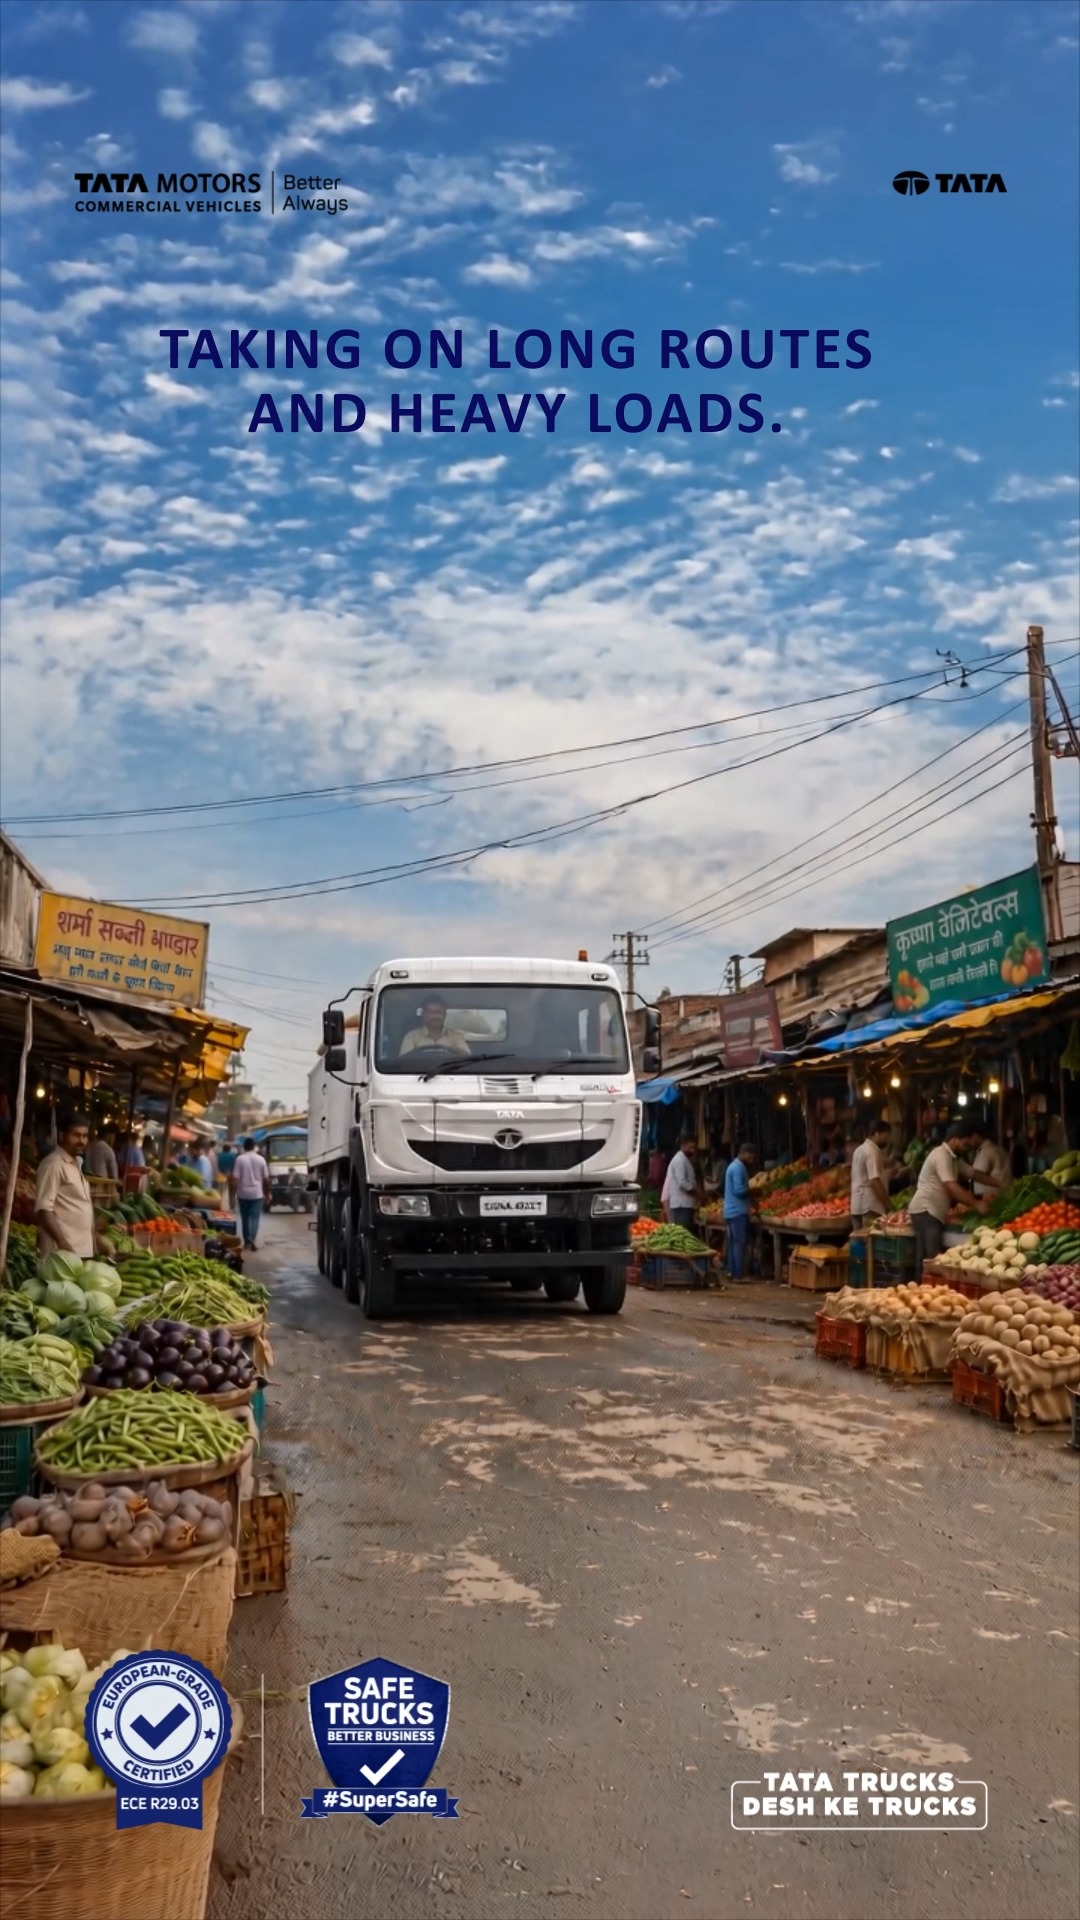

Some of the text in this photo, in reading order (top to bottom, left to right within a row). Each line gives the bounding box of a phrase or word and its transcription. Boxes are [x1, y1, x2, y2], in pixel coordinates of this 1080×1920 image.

[57, 908, 94, 937] शर्मा
[894, 922, 934, 961] कृष्णा
[496, 1111, 525, 1119] TATA
